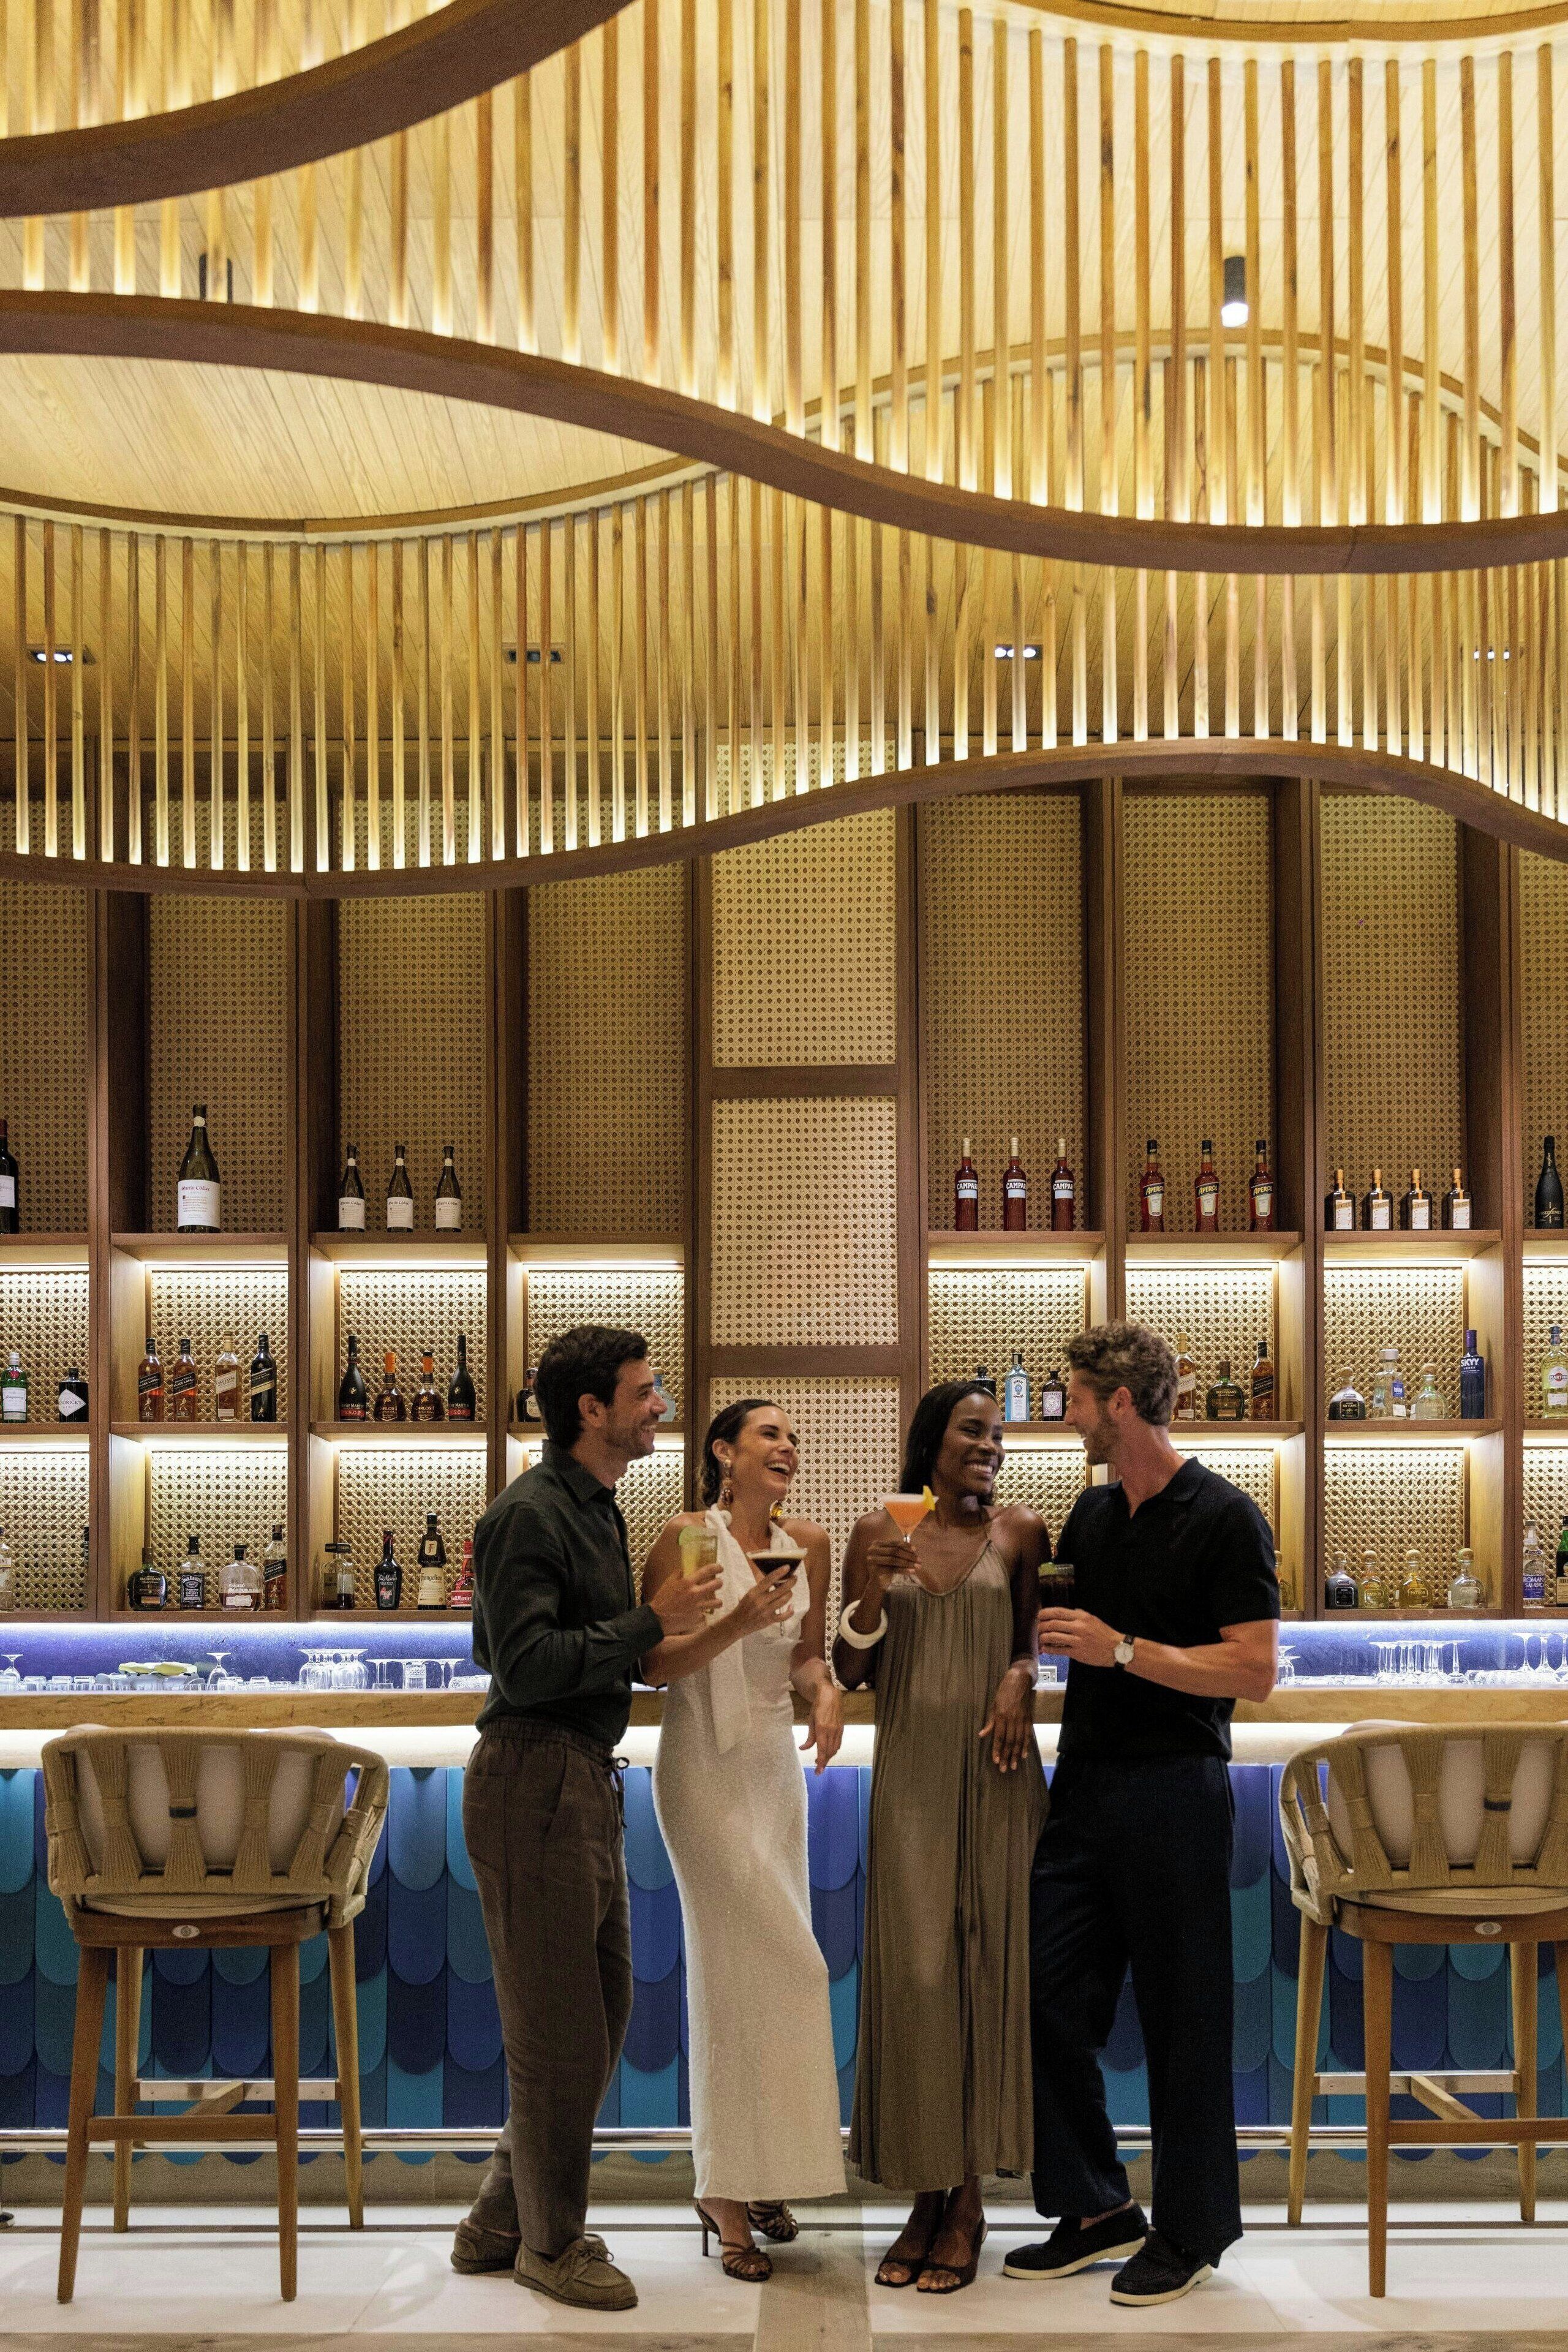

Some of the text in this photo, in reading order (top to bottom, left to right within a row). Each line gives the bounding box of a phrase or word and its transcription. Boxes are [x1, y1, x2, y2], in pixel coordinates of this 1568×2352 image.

[1199, 1185, 1218, 1194] APEROL
[1253, 1186, 1273, 1194] APEROL
[1461, 1358, 1480, 1367] SKYY
